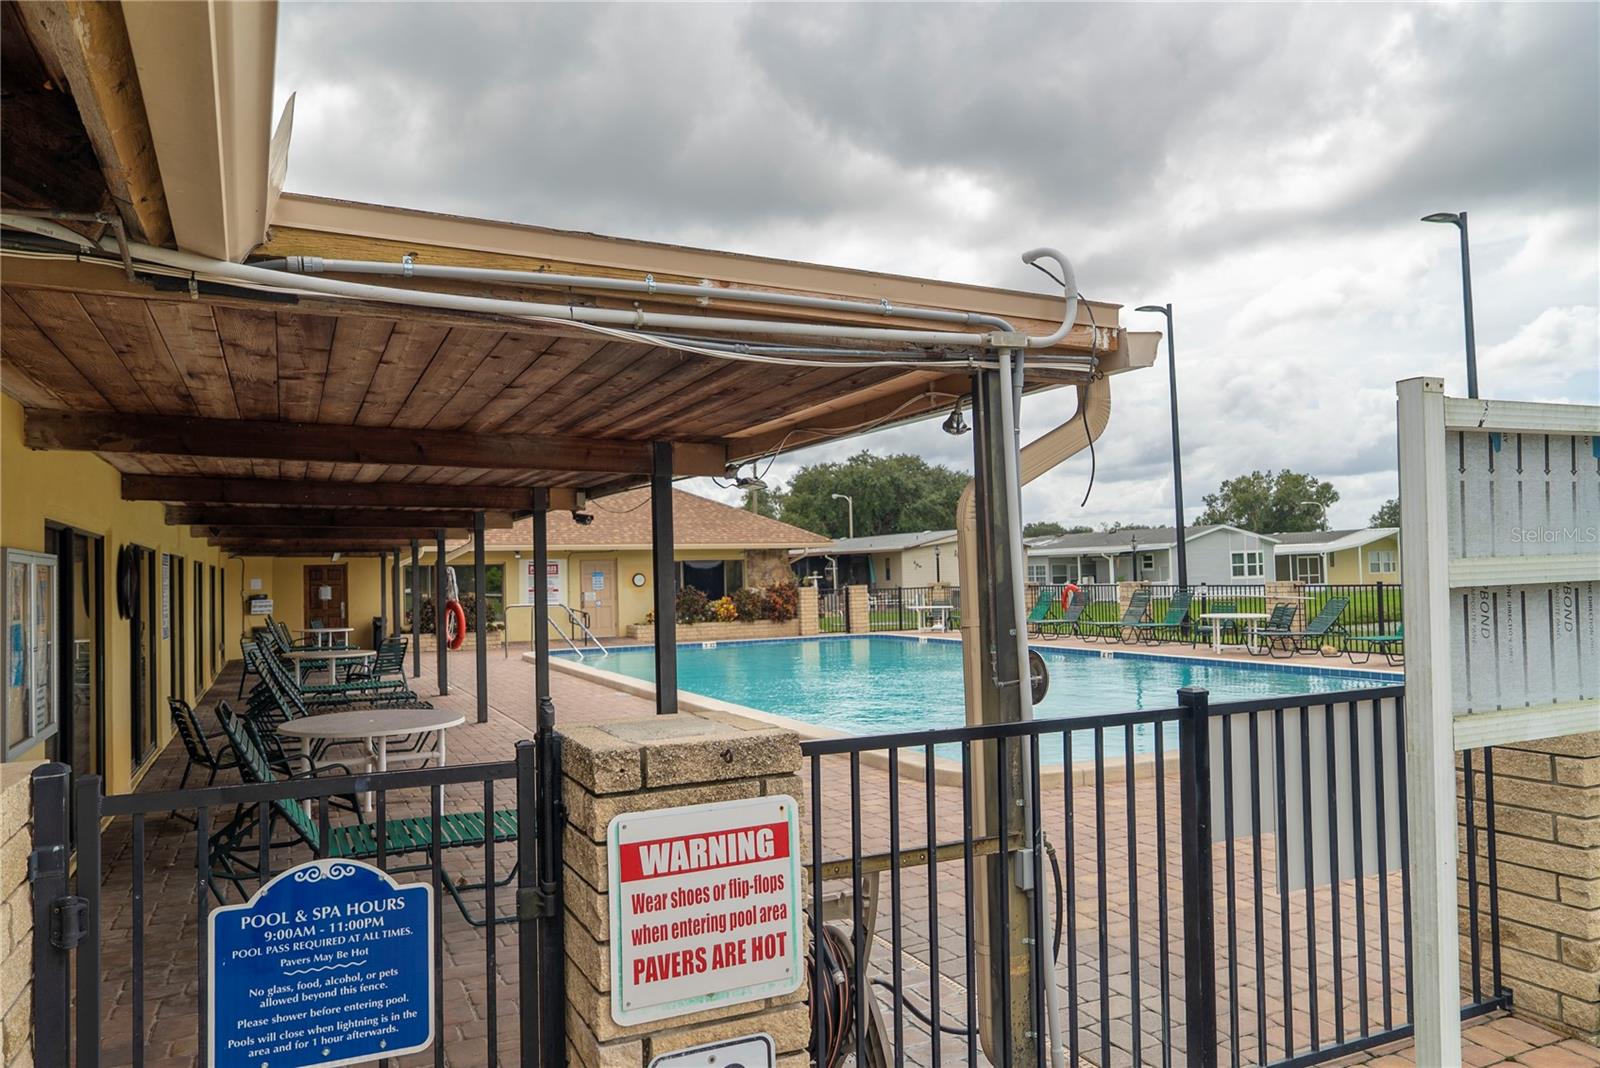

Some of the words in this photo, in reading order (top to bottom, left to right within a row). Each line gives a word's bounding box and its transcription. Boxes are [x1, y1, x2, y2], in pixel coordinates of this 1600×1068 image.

[639, 828, 775, 876] WARNING
[631, 893, 667, 914] Wear
[671, 887, 710, 908] shoes
[713, 885, 726, 901] or
[728, 873, 784, 899] flip-flops
[241, 913, 289, 929] POOL
[295, 911, 307, 923] &
[313, 907, 341, 921] SPA
[347, 897, 405, 916] HOURS
[264, 925, 316, 941] 9:00AM
[330, 917, 384, 933] 11:00PM
[631, 923, 668, 946] when
[671, 913, 727, 939] entering
[730, 911, 757, 930] pool
[760, 903, 787, 922] area
[232, 948, 263, 959] POOL
[266, 944, 289, 955] PASS
[293, 937, 345, 952] REQUIRED
[348, 934, 360, 943] AT
[363, 932, 380, 941] ALL
[383, 928, 413, 939] TIMES.
[280, 957, 311, 967] Pavers
[313, 952, 333, 964] May
[336, 951, 349, 959] Be
[351, 948, 368, 957] Hot
[633, 946, 707, 985] PAVERS
[712, 939, 746, 971] ARE
[752, 931, 787, 962] HOT
[249, 988, 264, 998] No
[267, 983, 294, 997] glass,
[297, 979, 322, 991] food,
[325, 973, 363, 987] alcohol,
[366, 972, 376, 980] or
[379, 968, 398, 980] pets
[260, 995, 299, 1008] allowed
[301, 989, 337, 1003] beyond
[340, 985, 357, 995] this
[360, 980, 388, 992] fence.
[237, 1017, 268, 1029] Please
[271, 1011, 307, 1023] shower
[310, 1006, 341, 1017] before
[344, 999, 383, 1013] entering
[386, 994, 409, 1006] pool.
[228, 1037, 254, 1049] Pools
[258, 1034, 276, 1044] will
[279, 1029, 304, 1040] close
[307, 1026, 333, 1037] when
[336, 1016, 378, 1033] lightning
[381, 1015, 389, 1023] is
[391, 1013, 400, 1021] in
[403, 1009, 417, 1019] the
[248, 1047, 270, 1058] area
[273, 1043, 292, 1055] and
[295, 1039, 309, 1049] for
[313, 1037, 317, 1046] 1
[321, 1033, 343, 1045] hour
[347, 1025, 399, 1041] afterwards.
